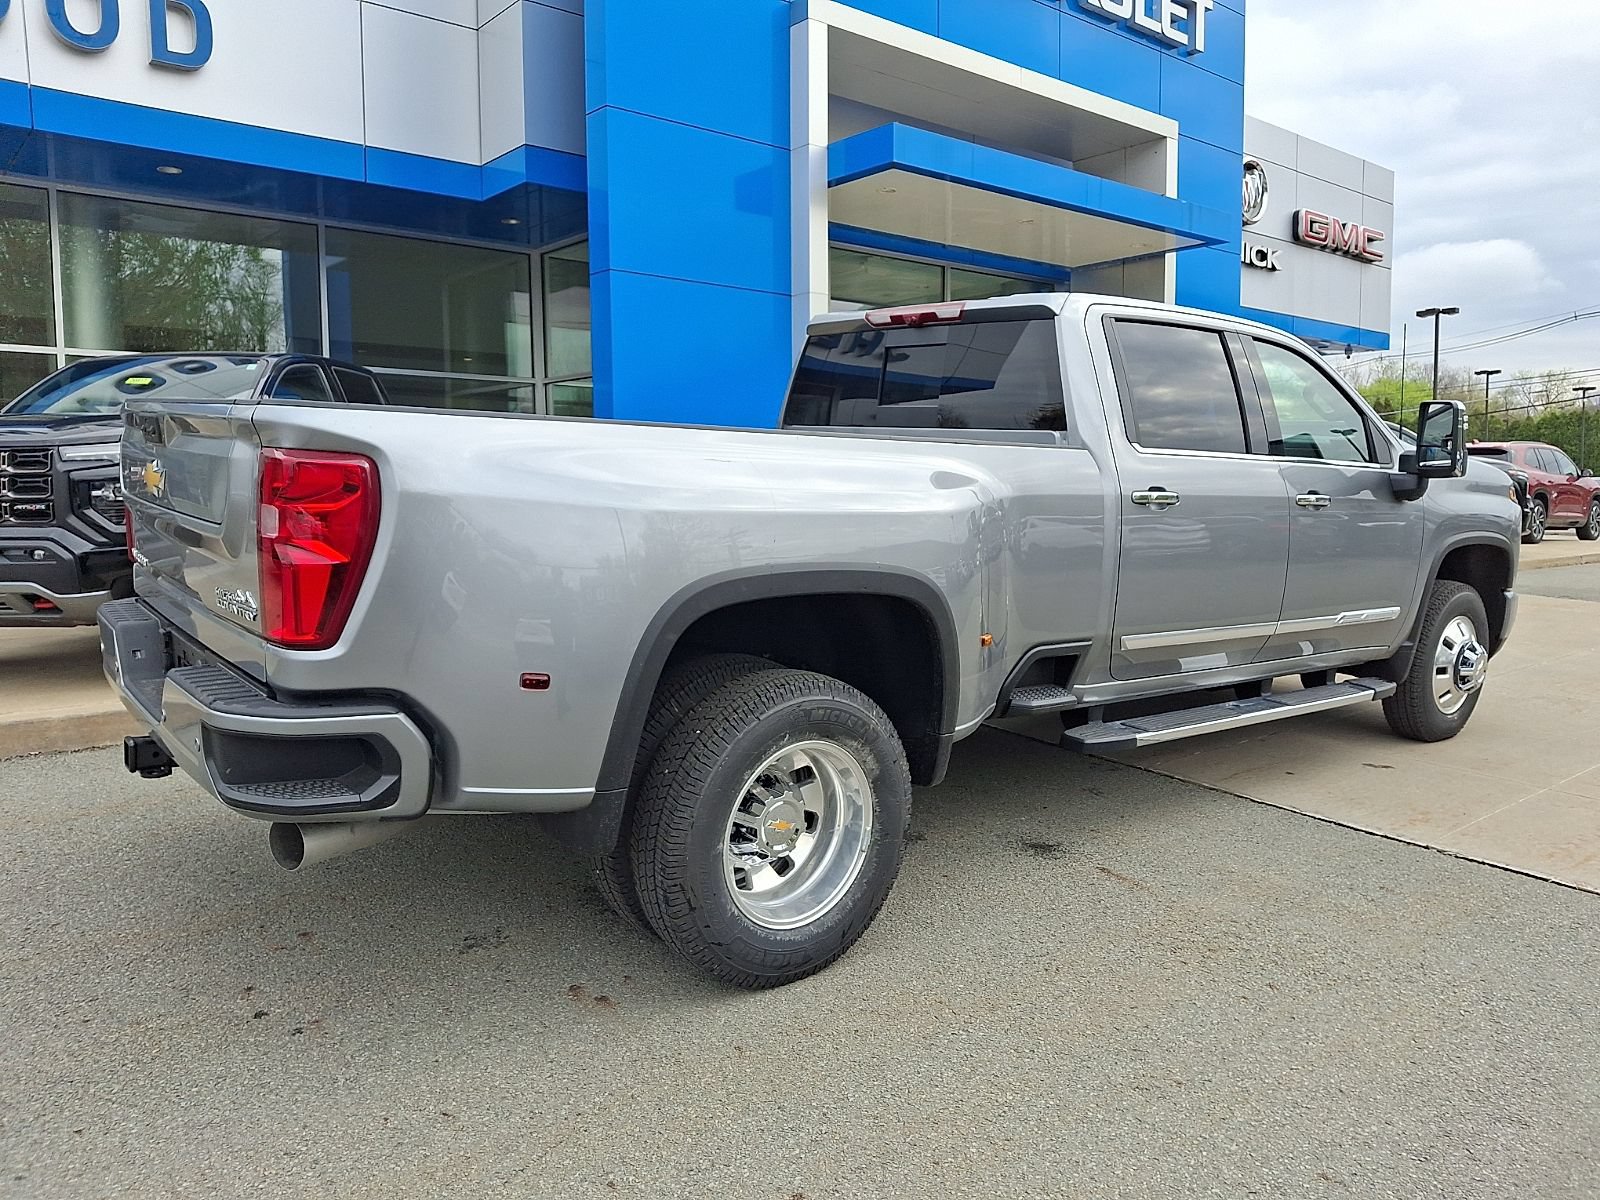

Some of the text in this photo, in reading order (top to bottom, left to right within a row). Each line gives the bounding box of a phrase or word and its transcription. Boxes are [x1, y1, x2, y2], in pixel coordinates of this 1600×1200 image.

[0, 0, 214, 71] OD
[1242, 241, 1281, 271] ICK
[1297, 208, 1385, 262] GMC
